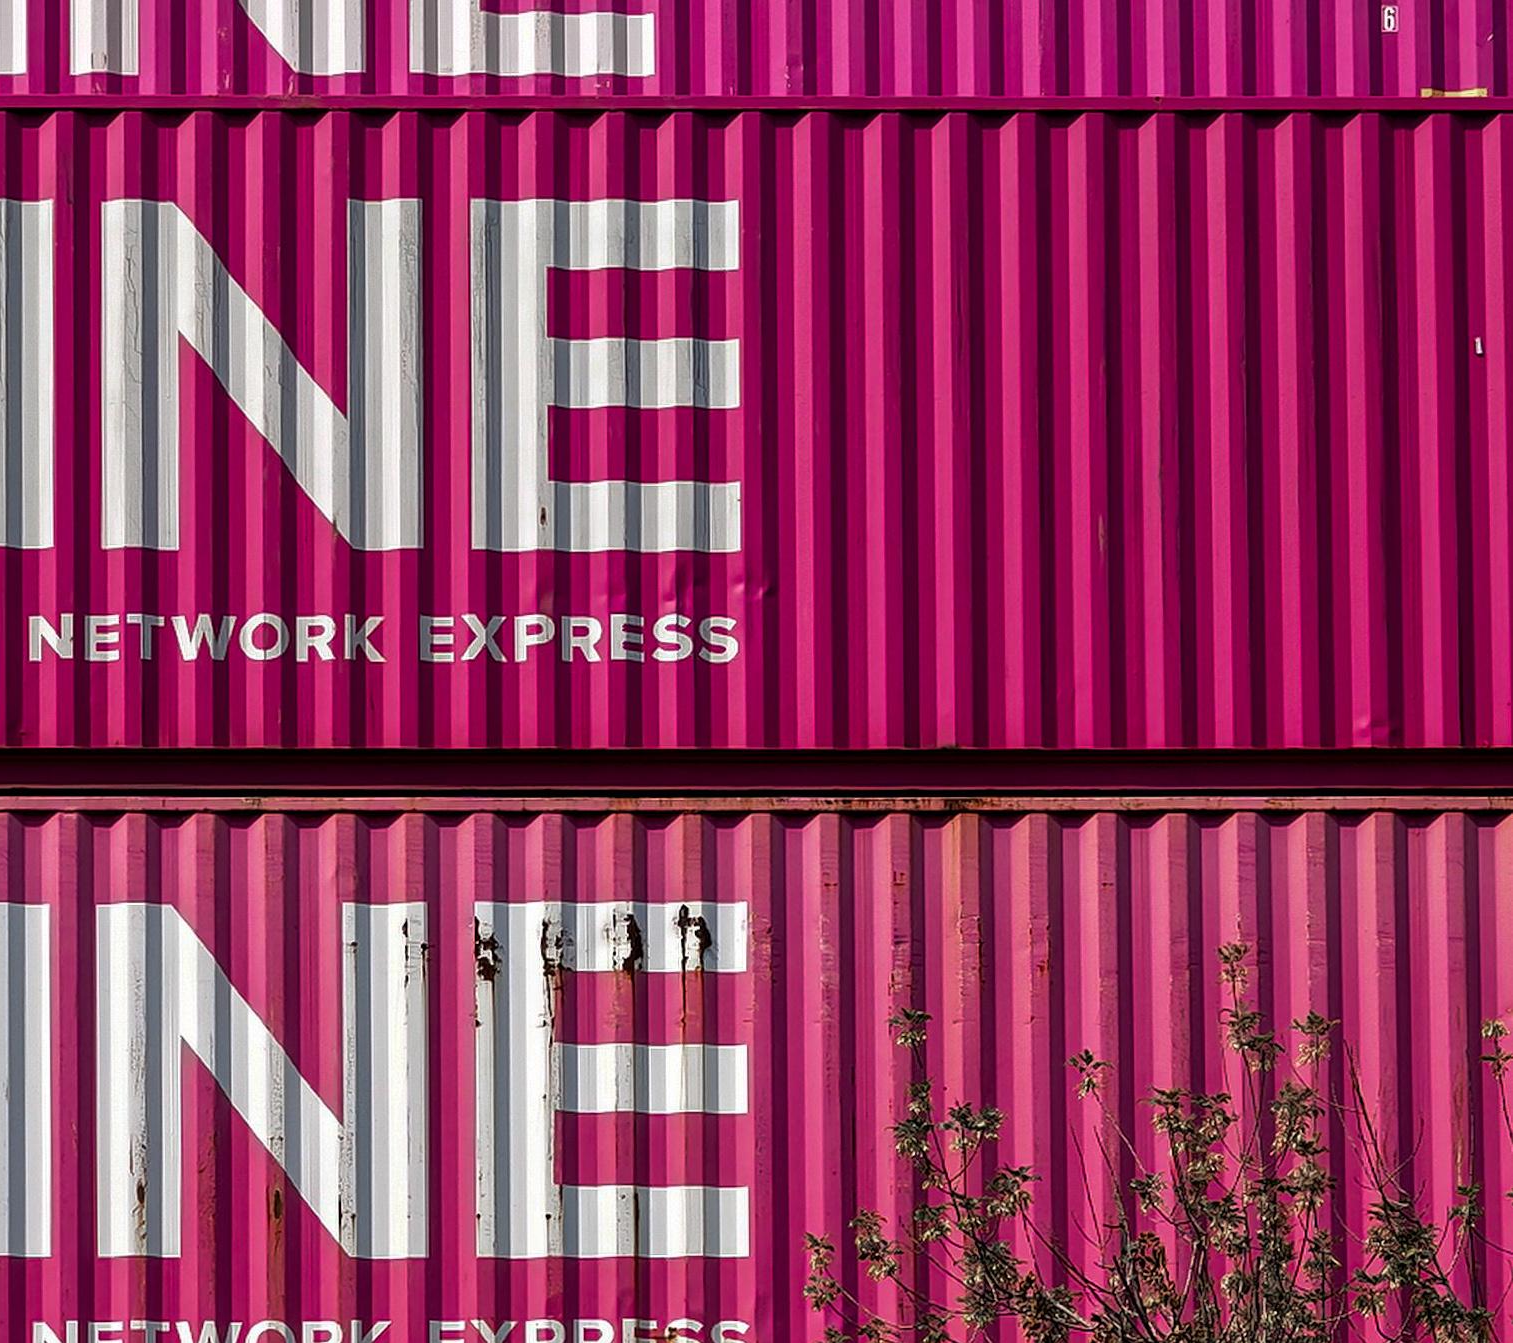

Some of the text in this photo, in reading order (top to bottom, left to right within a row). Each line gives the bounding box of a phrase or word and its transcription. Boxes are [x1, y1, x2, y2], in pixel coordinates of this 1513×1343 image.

[1383, 5, 1396, 31] 6
[28, 612, 386, 663] NETWORK
[421, 614, 740, 664] EXPRESS
